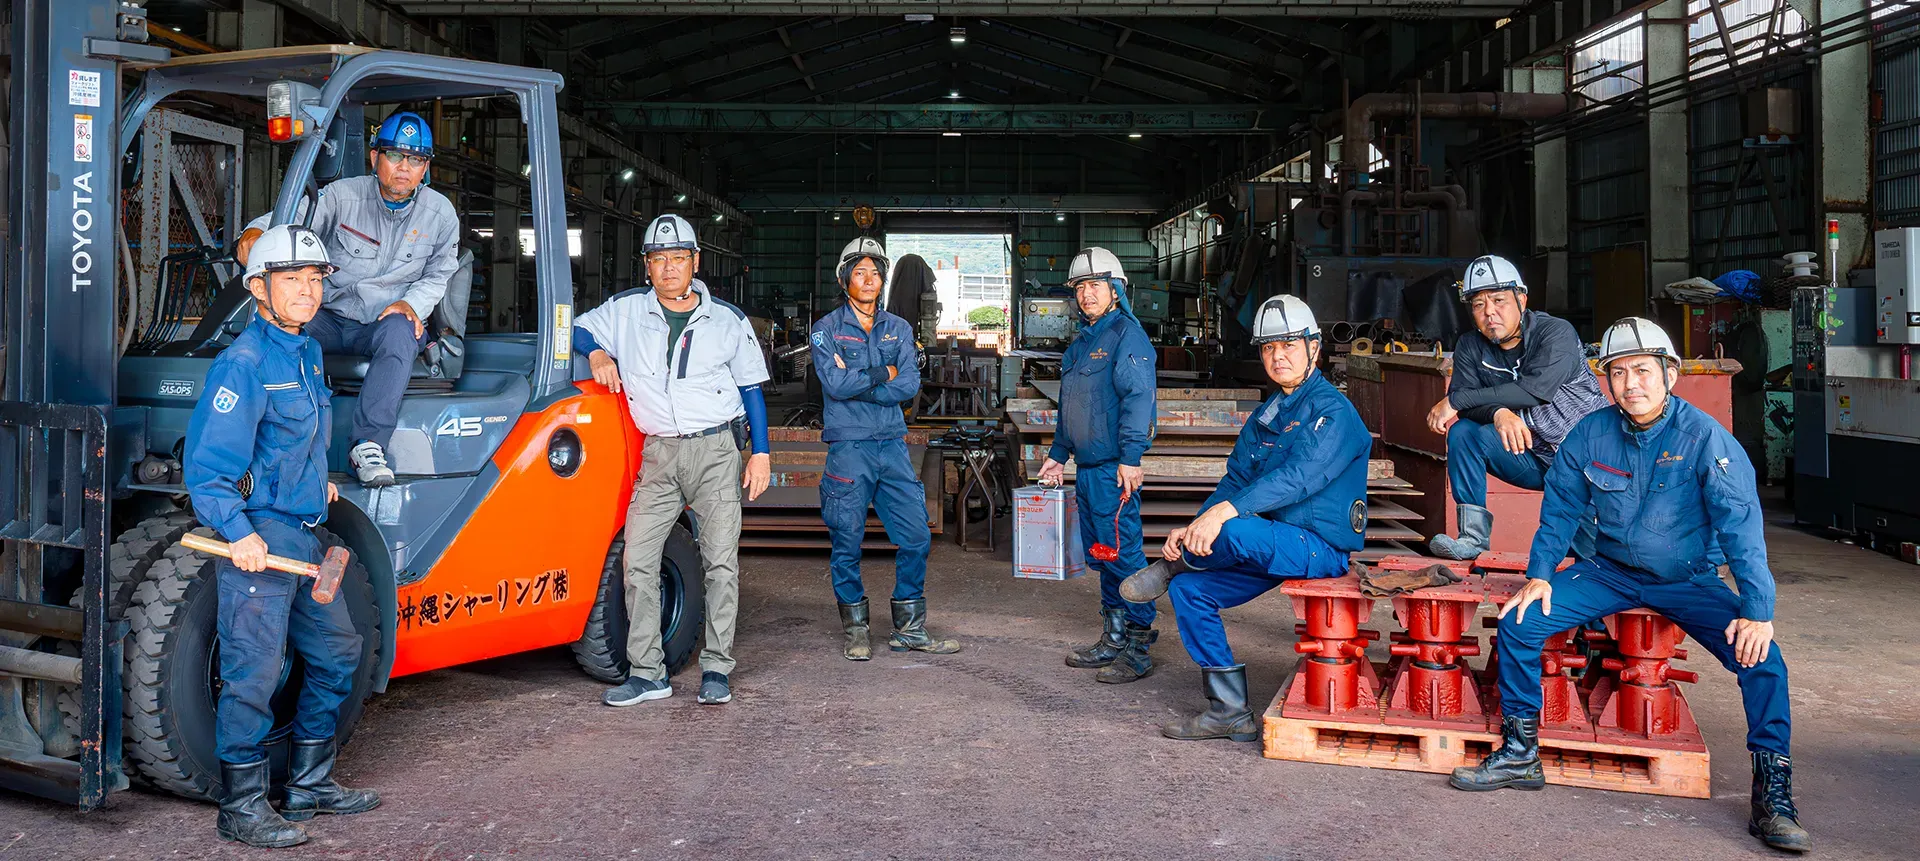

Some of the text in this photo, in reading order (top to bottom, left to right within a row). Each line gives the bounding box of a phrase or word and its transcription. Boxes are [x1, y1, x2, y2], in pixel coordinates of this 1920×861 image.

[72, 171, 93, 292] TOYOTA
[1313, 264, 1322, 278] 3
[436, 416, 483, 437] 45
